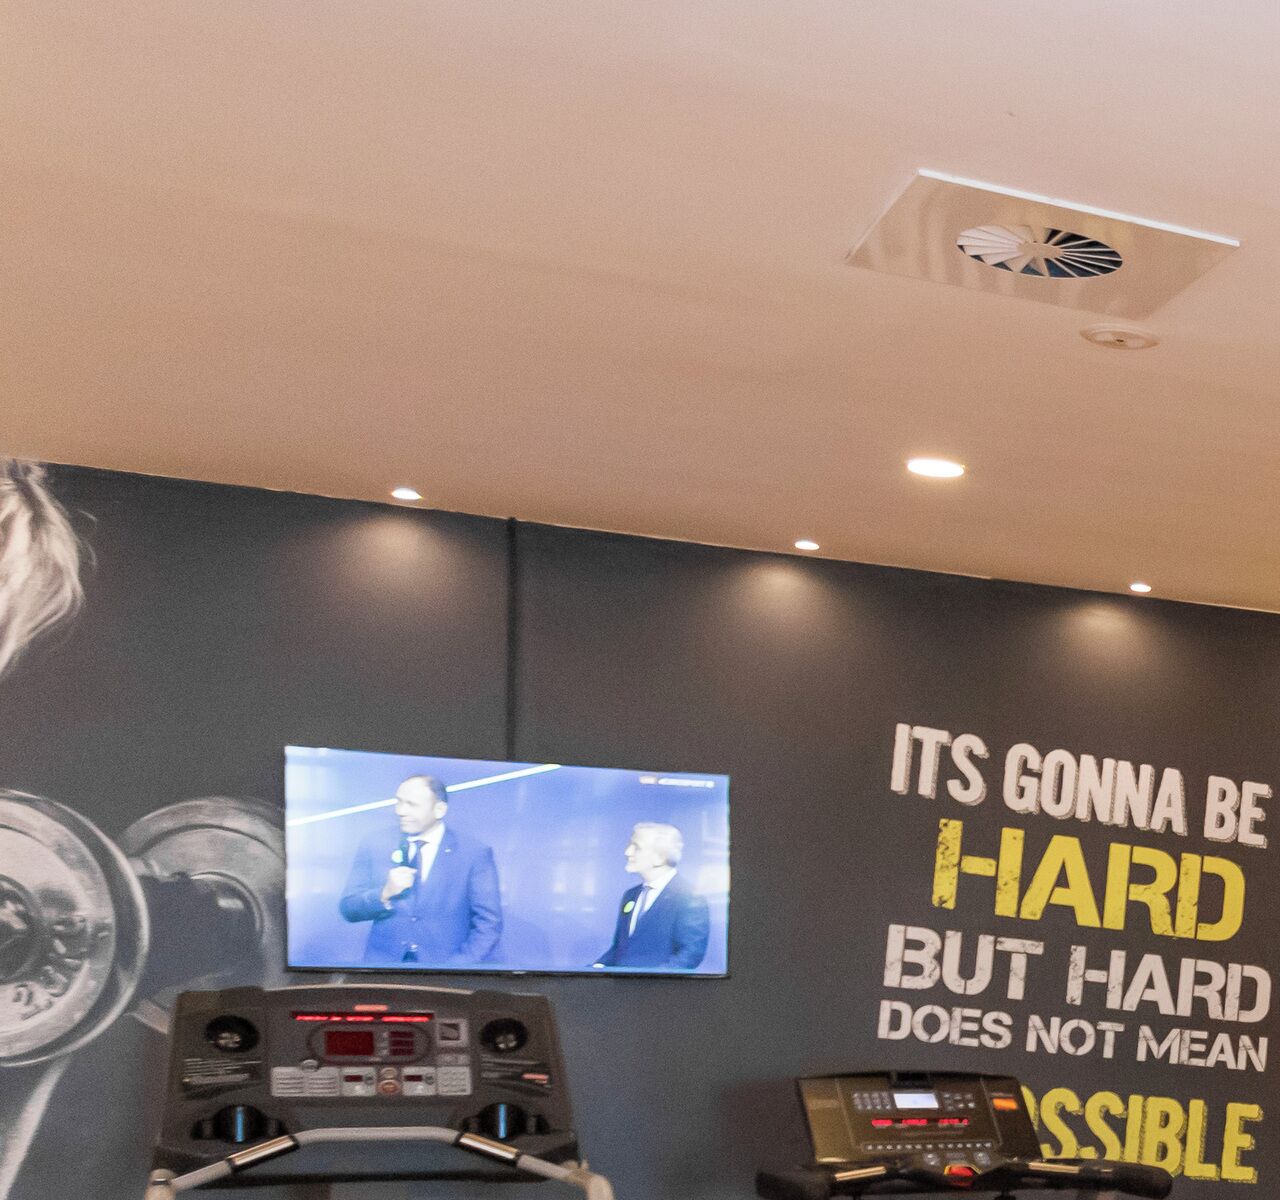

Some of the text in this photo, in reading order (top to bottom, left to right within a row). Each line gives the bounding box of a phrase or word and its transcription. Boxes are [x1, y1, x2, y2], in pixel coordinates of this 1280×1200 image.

[890, 722, 1273, 849] ITS GONNA BE
[931, 818, 1246, 942] HARD
[883, 923, 1272, 1023] BUT HARD
[877, 1000, 1269, 1072] DOES NOT MEAN
